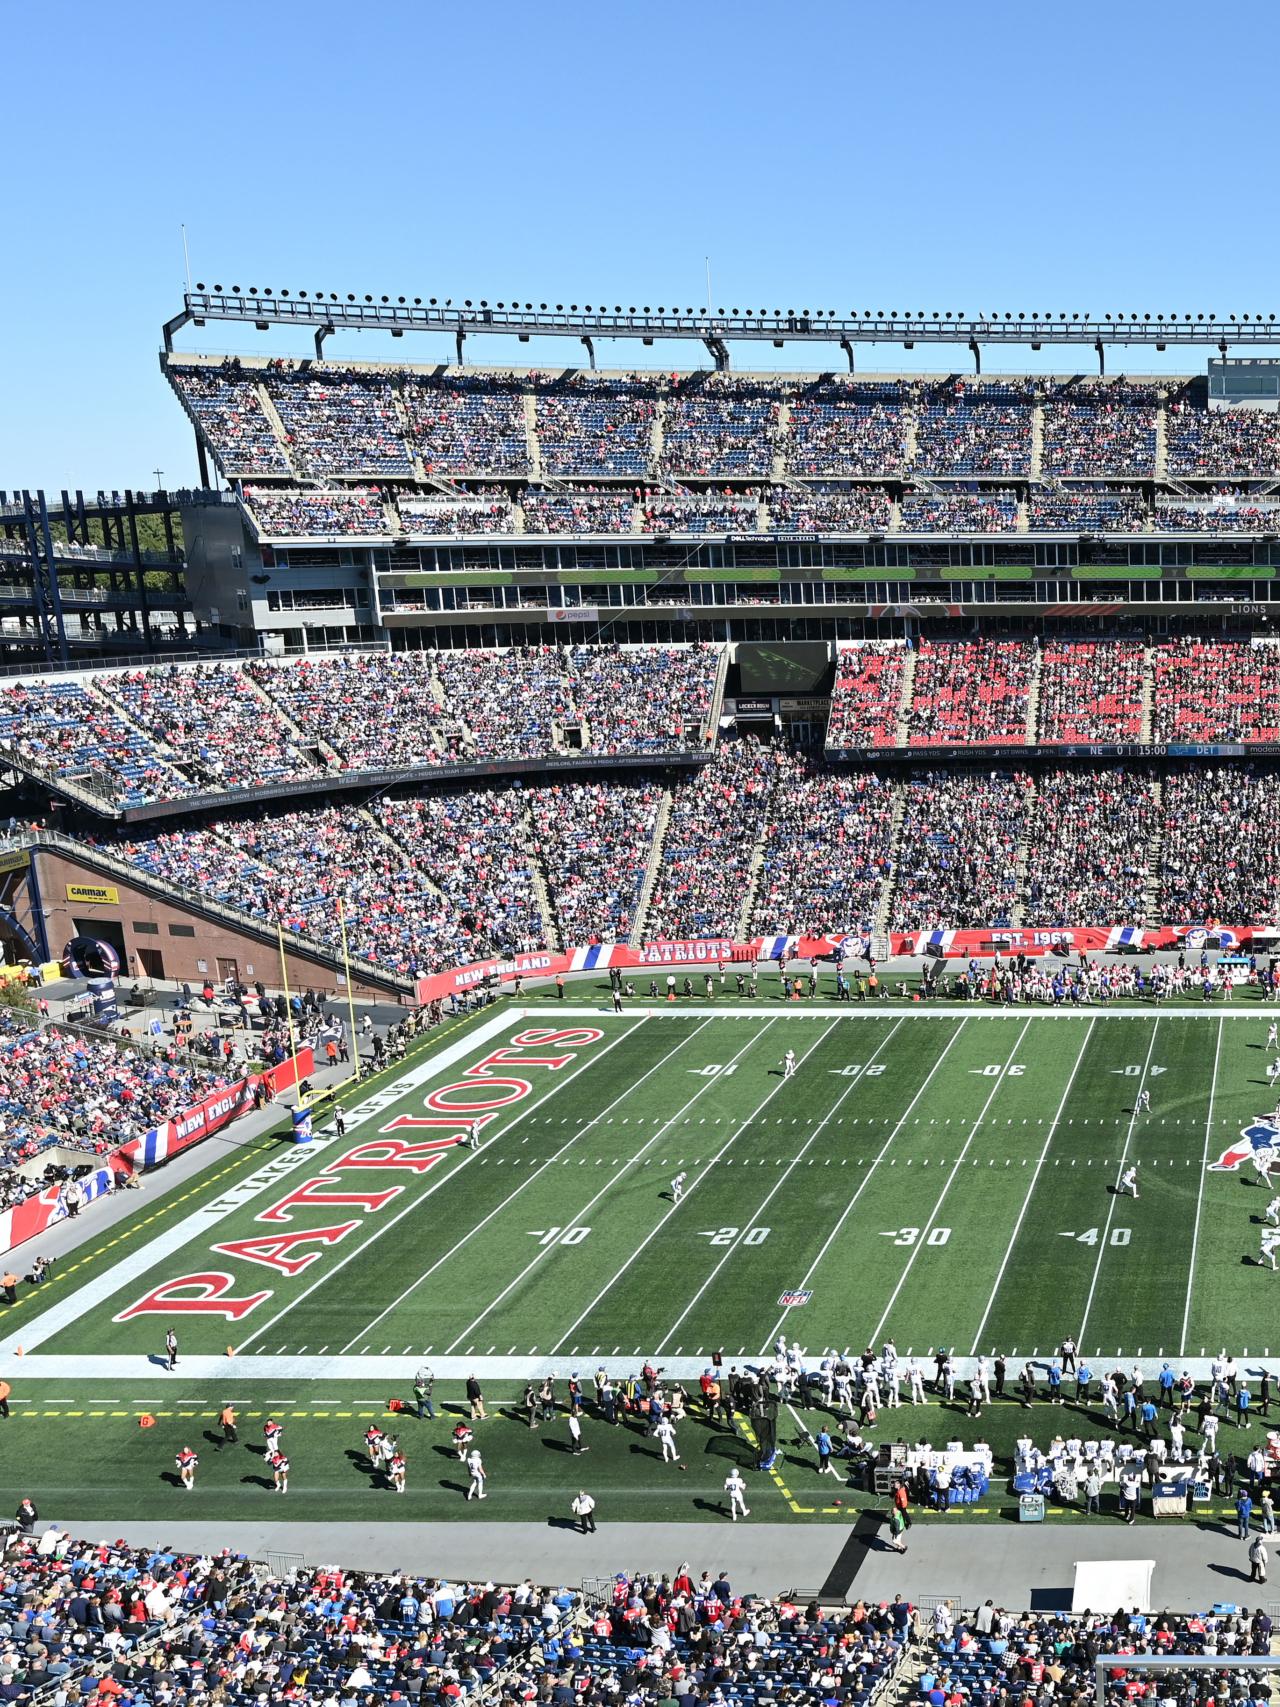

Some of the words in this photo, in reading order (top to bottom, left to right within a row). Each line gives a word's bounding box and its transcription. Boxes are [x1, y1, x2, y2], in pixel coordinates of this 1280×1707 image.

[567, 611, 590, 619] pepsi
[1231, 605, 1266, 613] LIONS
[1090, 746, 1103, 755] NE
[1117, 746, 1123, 755] 0
[1139, 746, 1166, 755] 15:00
[1196, 746, 1214, 754] DET
[639, 940, 732, 963] PATRIOTS
[455, 969, 485, 986] NEW
[176, 1111, 205, 1140] NEW
[202, 1199, 239, 1213] IT
[239, 1147, 312, 1191] TAKES
[353, 1100, 383, 1114] OF
[390, 1082, 415, 1097] US
[112, 1027, 605, 1323] PATRIOTS
[538, 1227, 592, 1245] 10
[708, 1227, 772, 1245] 20
[893, 1227, 952, 1246] 30
[1075, 1228, 1132, 1246] 40
[783, 1295, 807, 1304] NFL
